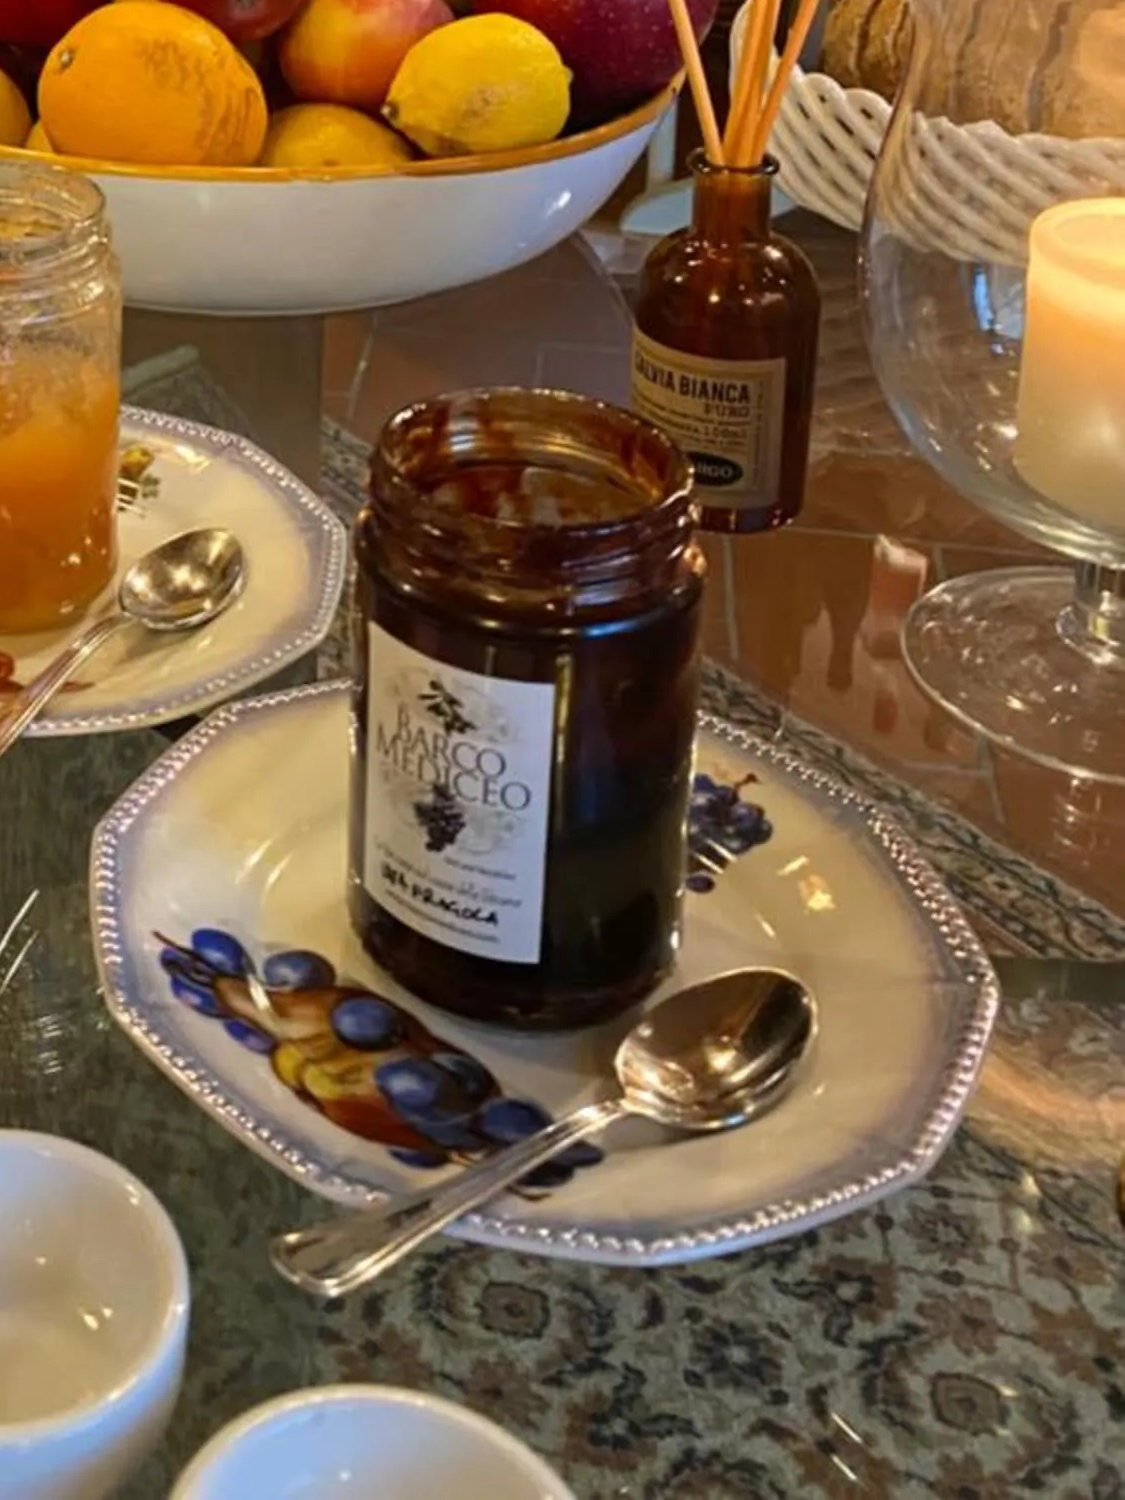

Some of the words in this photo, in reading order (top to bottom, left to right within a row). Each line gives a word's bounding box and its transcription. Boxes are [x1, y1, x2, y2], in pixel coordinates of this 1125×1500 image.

[679, 373, 750, 404] BIANCA
[376, 722, 533, 812] MEDICEO
[396, 703, 507, 779] BARCO
